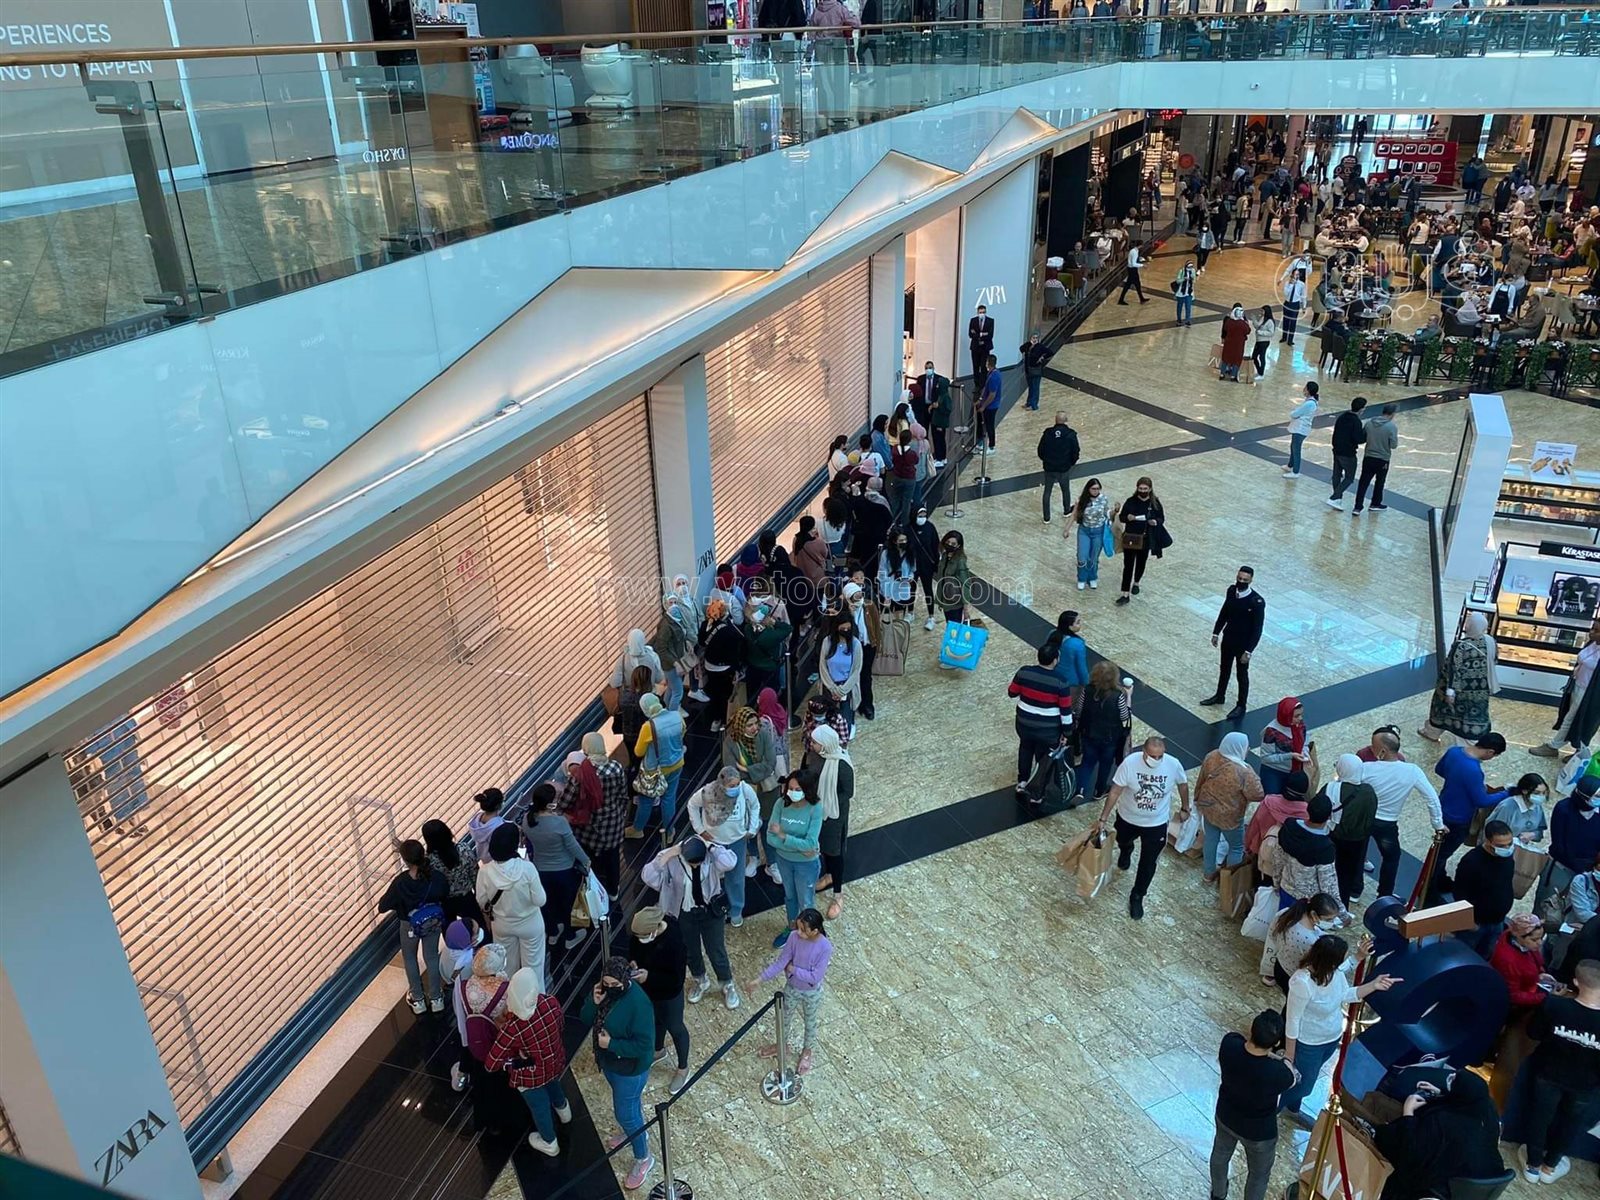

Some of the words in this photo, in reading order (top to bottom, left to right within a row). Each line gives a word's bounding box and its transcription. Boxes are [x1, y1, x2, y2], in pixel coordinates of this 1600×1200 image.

[975, 285, 1007, 309] ZARA
[697, 547, 715, 576] ZARA
[1136, 772, 1149, 782] THE
[1149, 774, 1168, 783] BEST
[94, 1108, 170, 1189] ZARA
